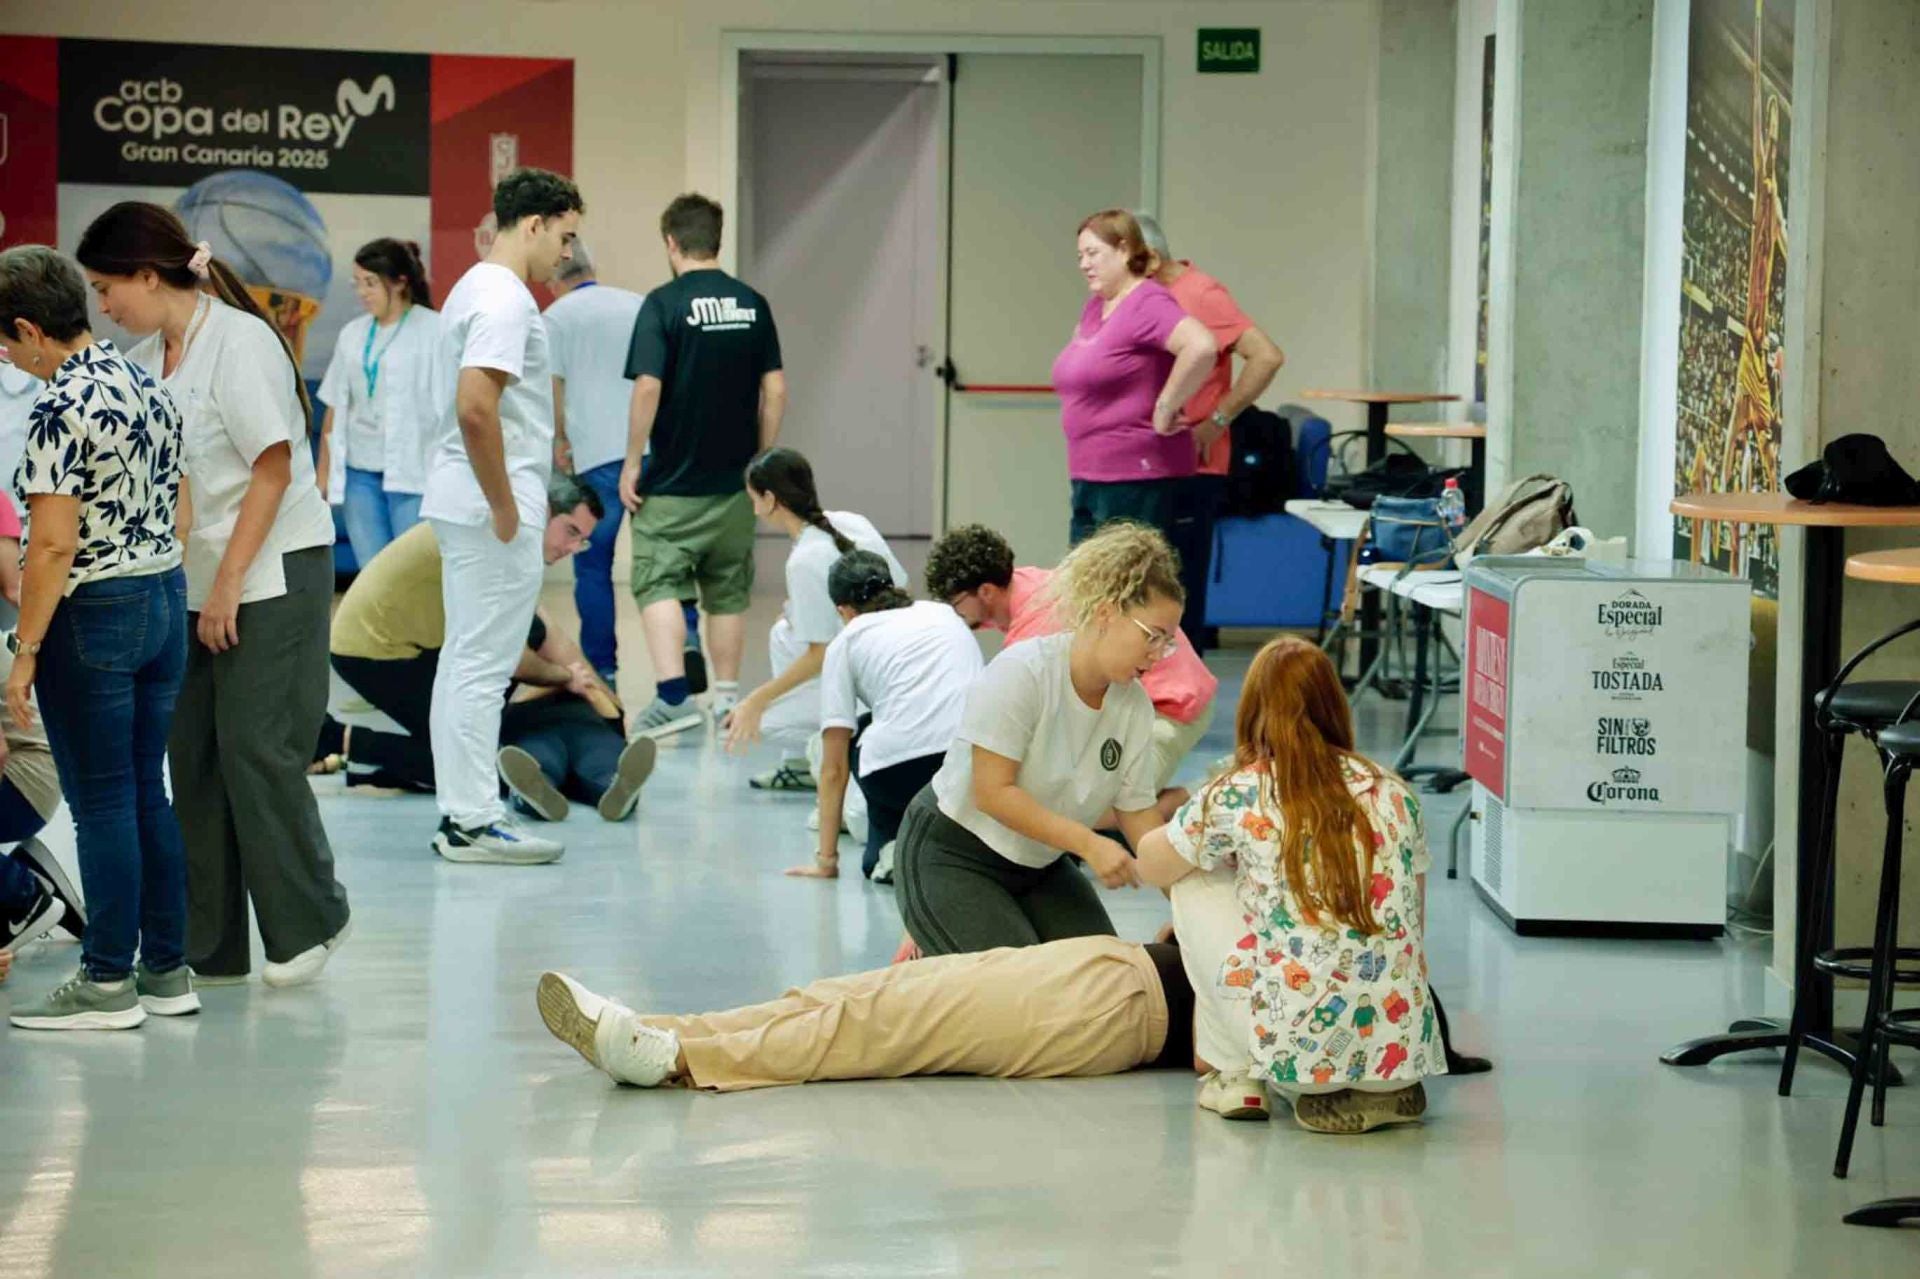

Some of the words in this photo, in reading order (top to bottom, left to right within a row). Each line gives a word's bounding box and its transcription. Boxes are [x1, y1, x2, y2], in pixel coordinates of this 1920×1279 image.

[1202, 41, 1256, 60] SALIDA
[119, 78, 183, 103] acb
[94, 96, 214, 140] Copa
[221, 108, 270, 133] del
[277, 104, 357, 149] Rey
[121, 141, 179, 163] Gran
[182, 143, 274, 167] Canaria
[277, 148, 330, 170] 2025
[1597, 604, 1663, 628] Especial
[1611, 601, 1652, 609] DORADA
[1592, 670, 1664, 691] TOSTADA
[1597, 717, 1625, 736] SIN
[1597, 736, 1656, 755] FILTROS
[1586, 781, 1661, 805] Corona
